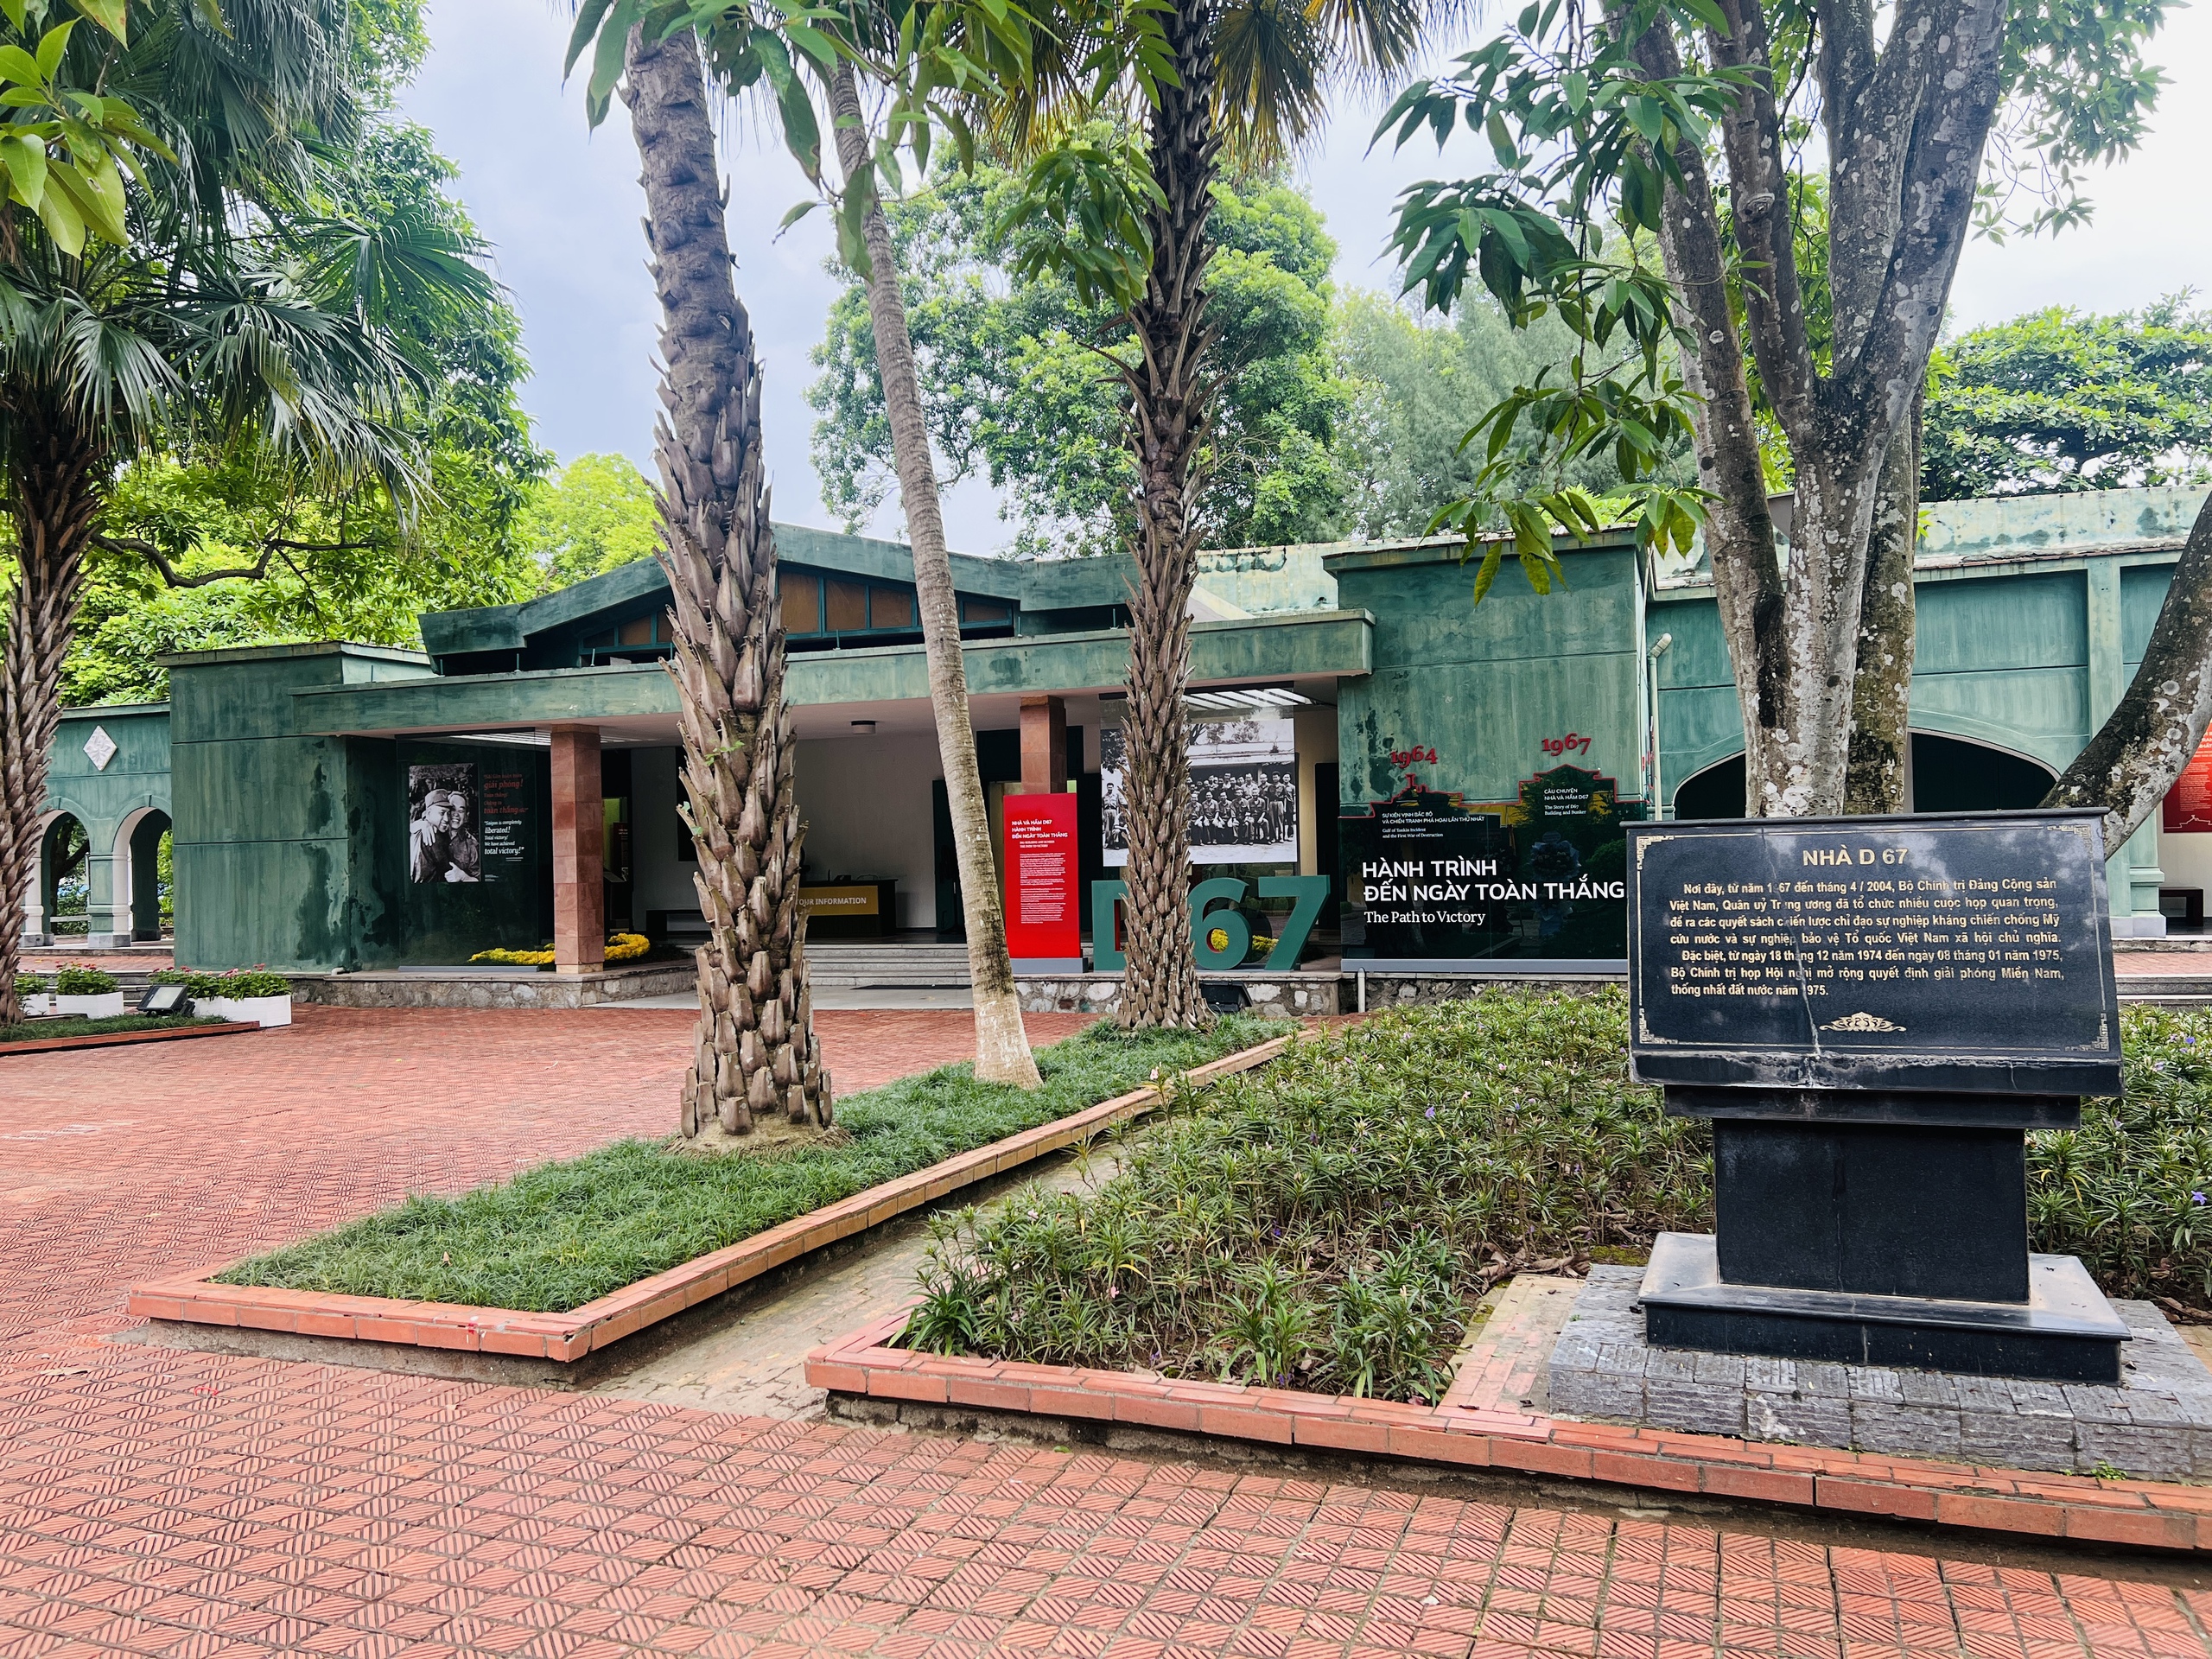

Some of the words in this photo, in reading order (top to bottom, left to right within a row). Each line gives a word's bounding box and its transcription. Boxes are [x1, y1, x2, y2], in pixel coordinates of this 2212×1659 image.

[1541, 733, 1592, 757] 1967
[1389, 745, 1438, 769] 1964
[1803, 844, 1853, 866] NHÀ
[1859, 849, 1876, 865] D
[1882, 848, 1909, 865] 67
[1362, 857, 1424, 878] HÀNH
[1431, 855, 1497, 877] TRÌNH
[1363, 879, 1407, 902] ĐẾN
[1414, 880, 1471, 901] NGÀY
[1475, 880, 1537, 900] TOÀN
[1543, 874, 1624, 899] THẮNG
[1684, 883, 1701, 894] Nơi
[1704, 882, 1725, 897] đây,
[1727, 882, 1739, 894] từ
[1742, 882, 1764, 894] năm
[1767, 882, 1790, 893] 167
[1795, 879, 1814, 893] đến
[1817, 881, 1847, 895] tháng
[1850, 881, 1857, 893] 4
[1867, 880, 1895, 893] 2004,
[1898, 880, 1913, 894] Bộ
[1917, 880, 1949, 892] Chính
[1954, 880, 1966, 893] trị
[1968, 878, 1999, 893] Đảng
[2002, 879, 2032, 893] Cộng
[2036, 877, 2056, 890] sản
[1669, 899, 1689, 913] Việt
[1693, 899, 1719, 912] Nam,
[1722, 899, 1750, 911] Quân
[1754, 898, 1767, 912] uỷ
[1770, 899, 1801, 912] Trng
[1805, 901, 1832, 912] ương
[1835, 898, 1849, 910] đã
[1853, 895, 1865, 909] tổ
[1868, 898, 1895, 909] chức
[1899, 895, 1929, 909] nhiều
[1934, 897, 1961, 912] cuộc
[1965, 897, 1986, 911] họp
[1992, 899, 2020, 911] quan
[2024, 897, 2058, 911] trọng,
[1363, 911, 1389, 924] The
[1391, 911, 1420, 924] Path
[1422, 912, 1435, 924] to
[1436, 911, 1486, 925] Victory
[1670, 913, 1682, 927] để
[1685, 918, 1695, 927] ra
[1698, 915, 1716, 927] các
[1719, 913, 1748, 930] quyết
[1750, 915, 1774, 927] sách
[1777, 912, 1805, 926] ciến
[1808, 915, 1831, 929] lược
[1834, 913, 1851, 926] chỉ
[1853, 915, 1873, 929] đạo
[1876, 918, 1891, 929] sự
[1892, 914, 1929, 929] nghiệp
[1933, 914, 1967, 929] kháng
[1970, 912, 2000, 925] chiến
[2004, 912, 2039, 928] chống
[2043, 913, 2060, 928] Mỹ
[1670, 932, 1689, 944] cứu
[1694, 932, 1720, 944] nước
[1725, 932, 1738, 944] và
[1742, 935, 1757, 947] sự
[1761, 932, 1796, 947] nghiệp
[1802, 931, 1821, 944] bảo
[1827, 932, 1840, 946] vệ
[1845, 930, 1859, 944] Tổ
[1865, 930, 1891, 946] quốc
[1897, 931, 1918, 946] Việt
[1924, 932, 1948, 944] Nam
[1955, 931, 1968, 944] xã
[1974, 931, 1992, 946] hội
[1999, 931, 2020, 944] chủ
[2026, 931, 2062, 946] nghĩa.
[1681, 950, 1702, 963] Đặc
[1704, 950, 1726, 963] biệt,
[1728, 950, 1740, 961] từ
[1742, 950, 1767, 963] ngày
[1770, 950, 1782, 961] 18
[1817, 950, 1829, 961] 12
[1832, 949, 1854, 961] năm
[1858, 950, 1882, 961] 1974
[1885, 947, 1905, 961] đến
[1908, 949, 1935, 963] ngày
[1937, 950, 1951, 961] 08
[1953, 949, 1986, 963] tháng
[1988, 950, 2001, 961] 01
[2005, 949, 2030, 961] năm
[2033, 950, 2063, 963] 1975,
[1670, 966, 1686, 981] Bộ
[1690, 966, 1720, 978] Chính
[1725, 967, 1737, 981] trị
[1741, 967, 1761, 981] họp
[1766, 967, 1783, 981] Hội
[1817, 966, 1834, 978] mở
[1839, 967, 1864, 981] rộng
[1869, 964, 1900, 982] quyết
[1904, 968, 1929, 982] định
[1934, 966, 1955, 982] giải
[1960, 967, 1996, 982] phóng
[2001, 965, 2029, 979] Miền
[2035, 968, 2064, 981] Nam,
[1671, 981, 1700, 998] thống
[1703, 982, 1726, 995] nhất
[1728, 982, 1745, 995] đất
[1747, 983, 1773, 995] nước
[1776, 983, 1799, 995] năm
[1802, 984, 1829, 995] 975.
